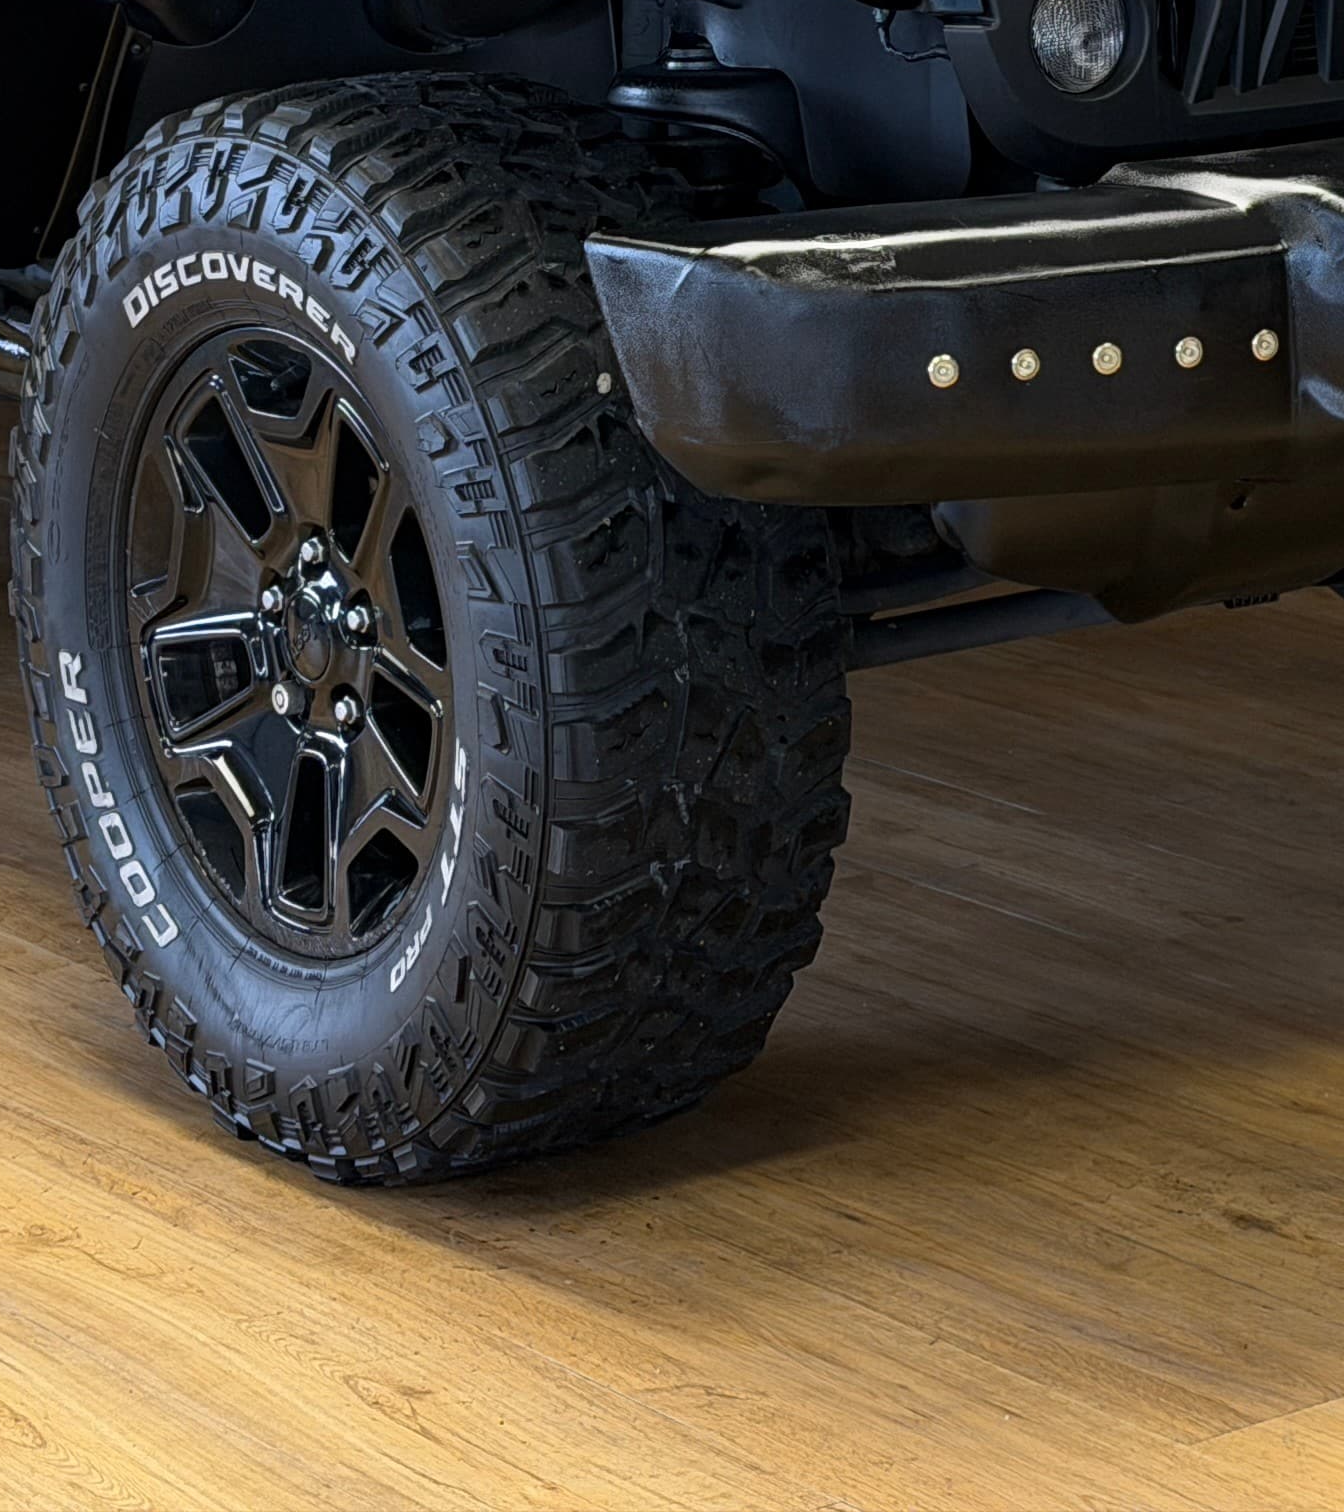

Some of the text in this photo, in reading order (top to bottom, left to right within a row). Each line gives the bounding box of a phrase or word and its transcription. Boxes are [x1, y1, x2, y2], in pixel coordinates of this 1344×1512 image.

[121, 251, 358, 366] DISCOVERER
[57, 649, 179, 948] COOPER
[390, 737, 467, 993] STT PRO
